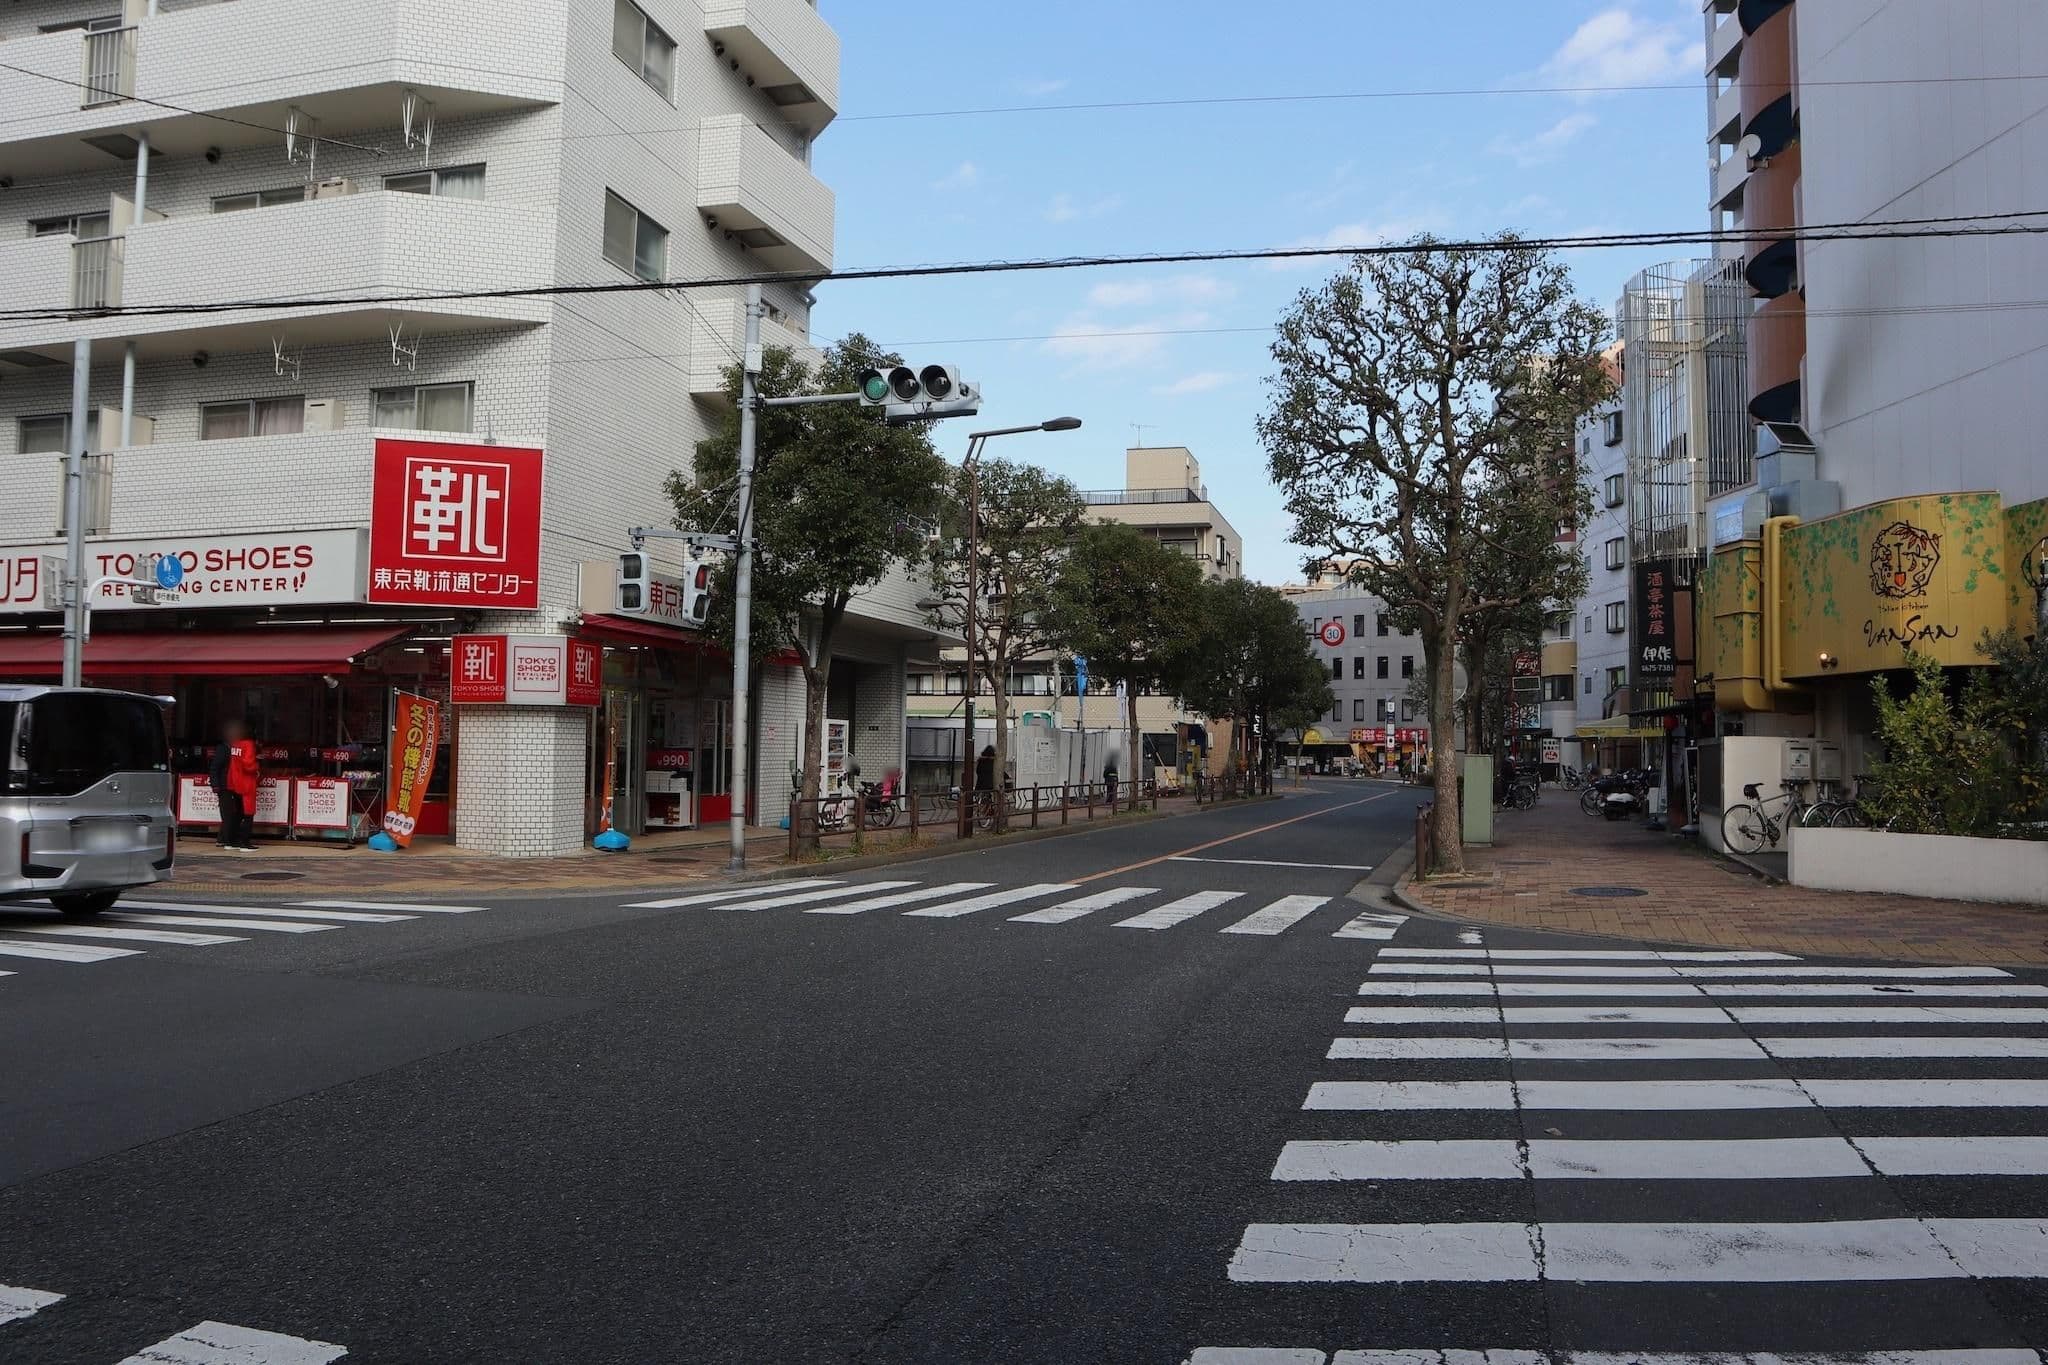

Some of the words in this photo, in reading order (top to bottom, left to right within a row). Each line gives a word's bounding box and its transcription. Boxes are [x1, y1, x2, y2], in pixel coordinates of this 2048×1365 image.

[413, 465, 500, 555] 靴
[96, 550, 198, 576] TOO
[204, 545, 314, 572] SHOES
[210, 578, 287, 593] CENTER
[374, 567, 534, 596] 東京靴流通センター
[1326, 628, 1339, 640] 30
[517, 656, 556, 665] TOKYO
[1642, 646, 1671, 661] 伊作
[464, 643, 495, 681] 靴
[517, 664, 556, 673] SHOES
[575, 646, 594, 684] 靴
[308, 792, 336, 800] TOKYO
